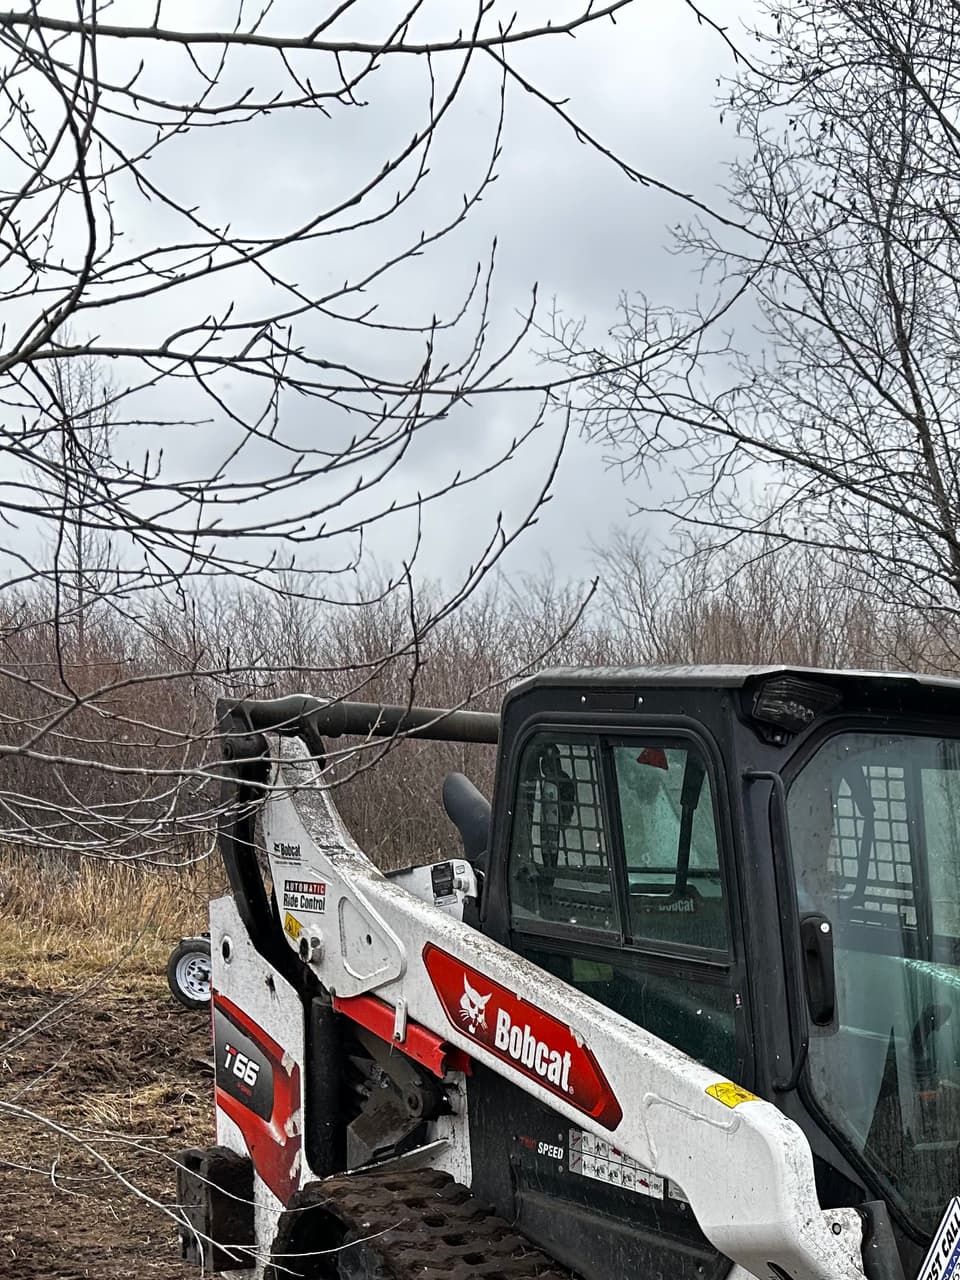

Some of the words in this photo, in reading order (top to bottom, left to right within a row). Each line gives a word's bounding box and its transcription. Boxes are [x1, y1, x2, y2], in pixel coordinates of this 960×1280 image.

[285, 881, 325, 895] AUTOMATIC
[283, 893, 299, 908] Ride
[300, 895, 325, 911] Control
[495, 1007, 571, 1092] Bobcat
[224, 1043, 260, 1087] T66
[537, 1141, 564, 1160] SPEED
